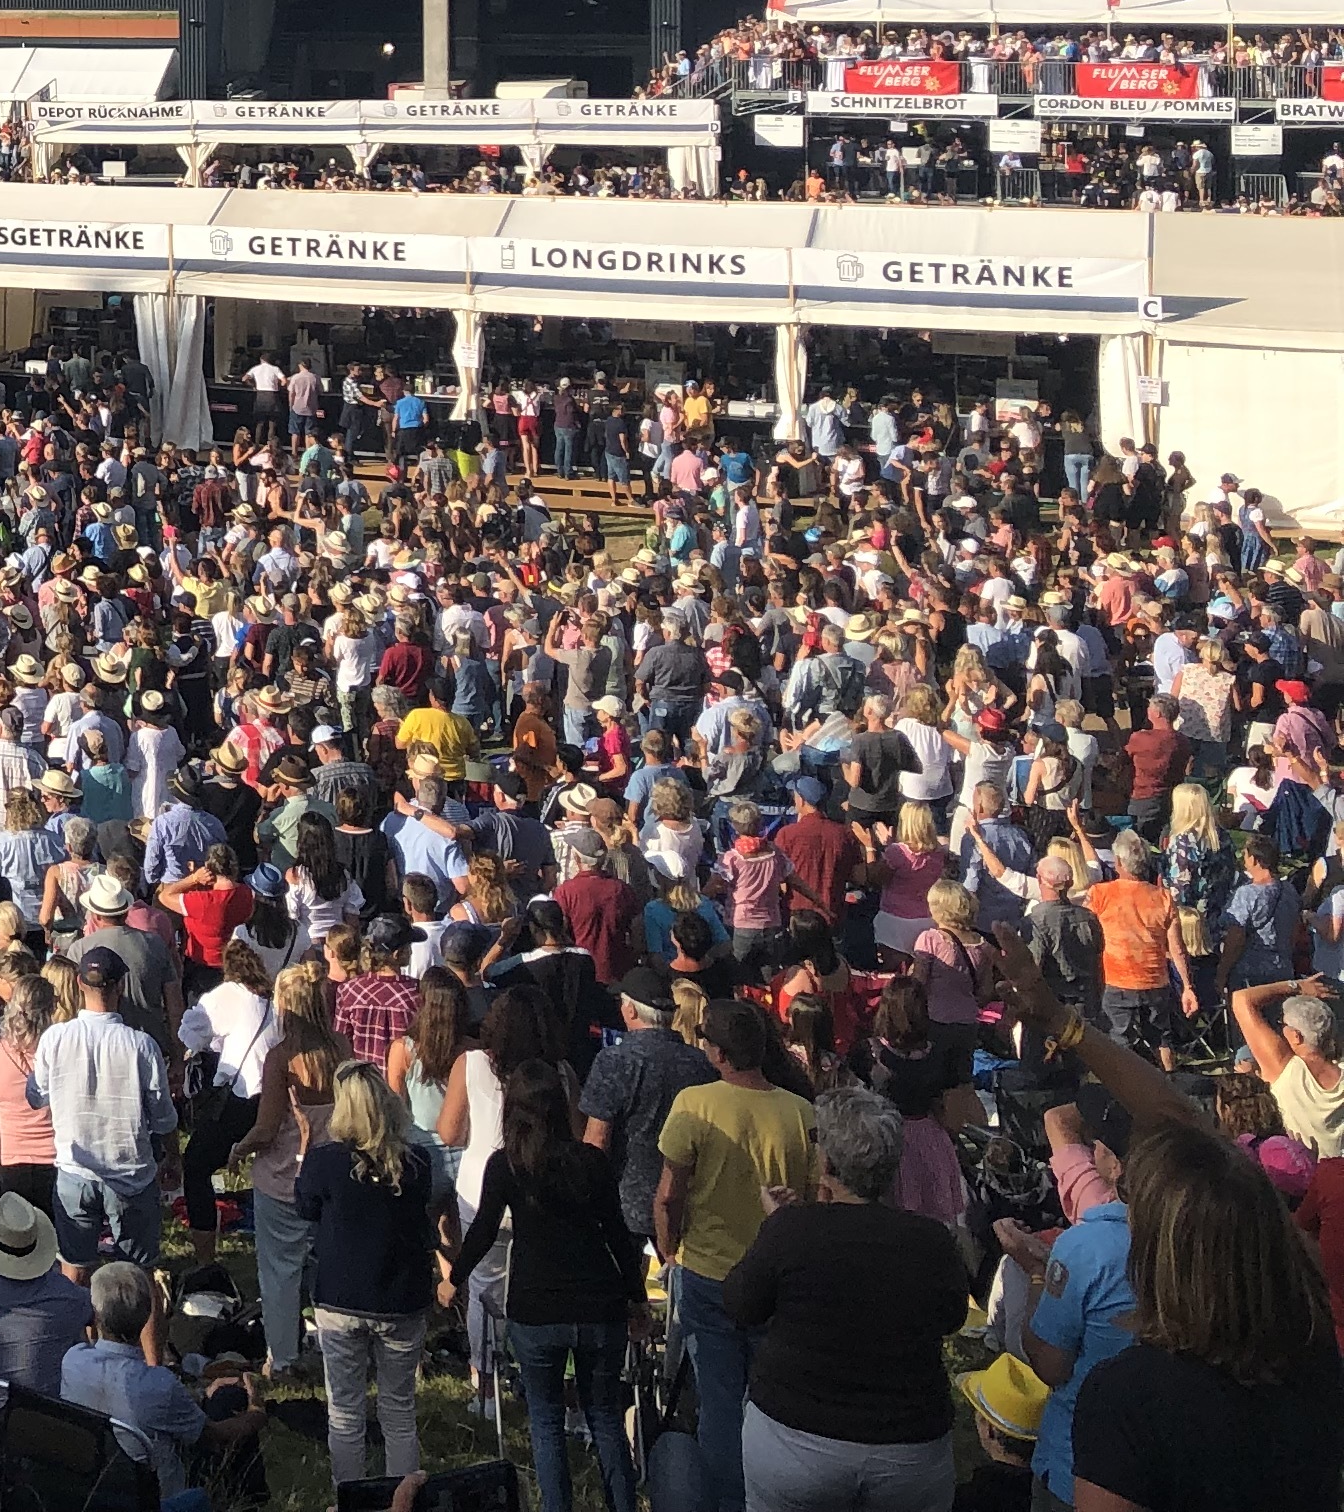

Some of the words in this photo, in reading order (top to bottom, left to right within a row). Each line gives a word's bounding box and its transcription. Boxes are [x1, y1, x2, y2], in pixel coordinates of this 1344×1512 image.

[858, 65, 931, 84] FLUMSER
[884, 76, 921, 87] BERG
[1092, 67, 1168, 87] FLUMSER
[1119, 79, 1158, 91] BERG
[235, 103, 326, 118] GETRÄNKE
[406, 101, 501, 116] GETRÄNKE
[580, 101, 678, 117] GETRÄNKE
[830, 96, 968, 110] SCHNITZELBROT
[1038, 98, 1107, 110] CORDON
[1110, 99, 1148, 111] BLEU
[1163, 100, 1234, 113] POMMES
[37, 106, 84, 118] DEPOT
[88, 104, 184, 119] RÜCKNAHME
[710, 122, 719, 132] D
[248, 234, 407, 262] GETRÄNKE
[531, 246, 746, 276] LONGDRINKS
[882, 258, 1074, 289] GETRÄNKE
[1142, 300, 1159, 318] C
